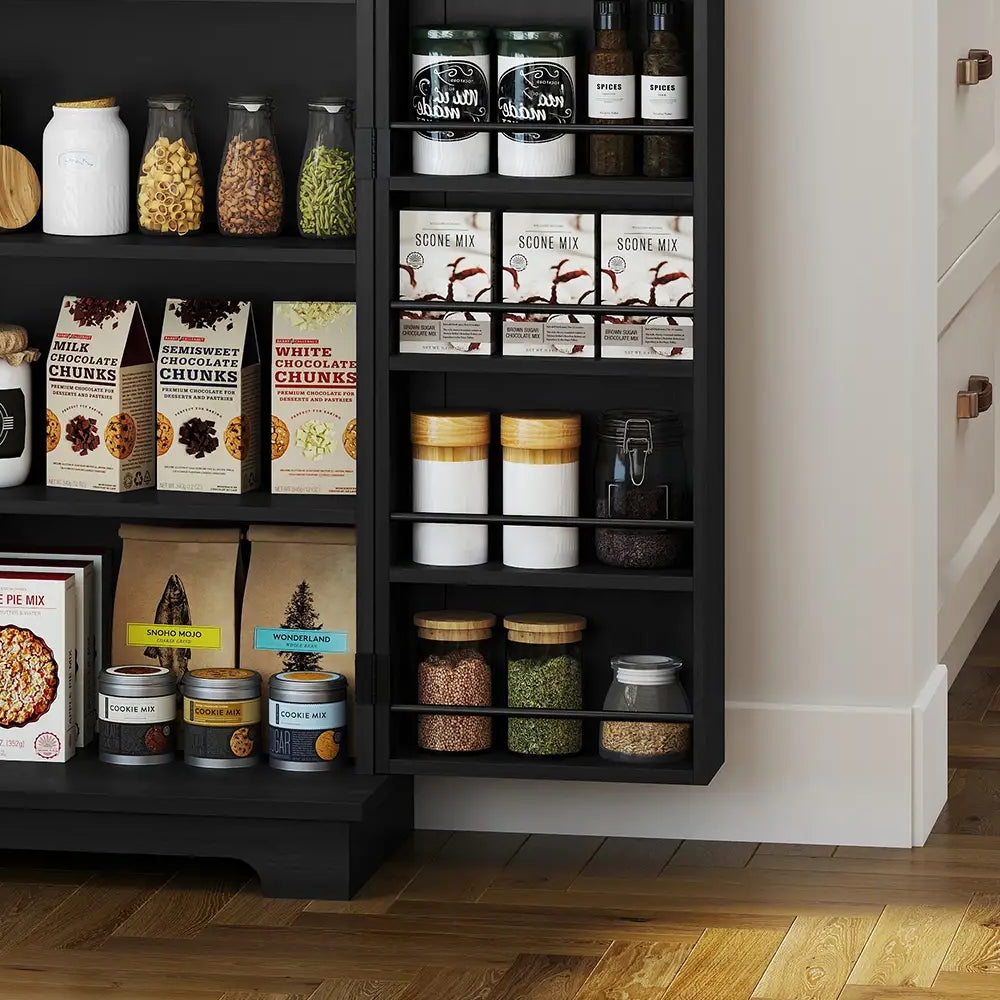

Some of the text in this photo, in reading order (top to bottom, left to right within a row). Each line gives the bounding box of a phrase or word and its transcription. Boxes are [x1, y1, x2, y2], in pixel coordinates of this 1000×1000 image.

[416, 234, 474, 247] SCONE MIX
[519, 236, 578, 249] SCONE MIX
[618, 238, 677, 251] SCONE MIX
[53, 341, 89, 352] MILK
[162, 346, 239, 356] SEMISWEET
[276, 347, 331, 357] WHITE
[50, 353, 118, 366] CHOCOLATE
[160, 357, 238, 367] CHOCOLATE
[275, 360, 356, 368] CHOCOLATE
[49, 365, 116, 381] CHUNKS
[160, 368, 237, 382] CHUNKS
[275, 371, 356, 383] CHUNKS
[7, 594, 22, 605] PIE
[26, 595, 45, 606] MIX
[147, 629, 176, 637] SNOHO
[273, 634, 330, 642] WONDERLAND
[281, 711, 309, 719] COOKIE
